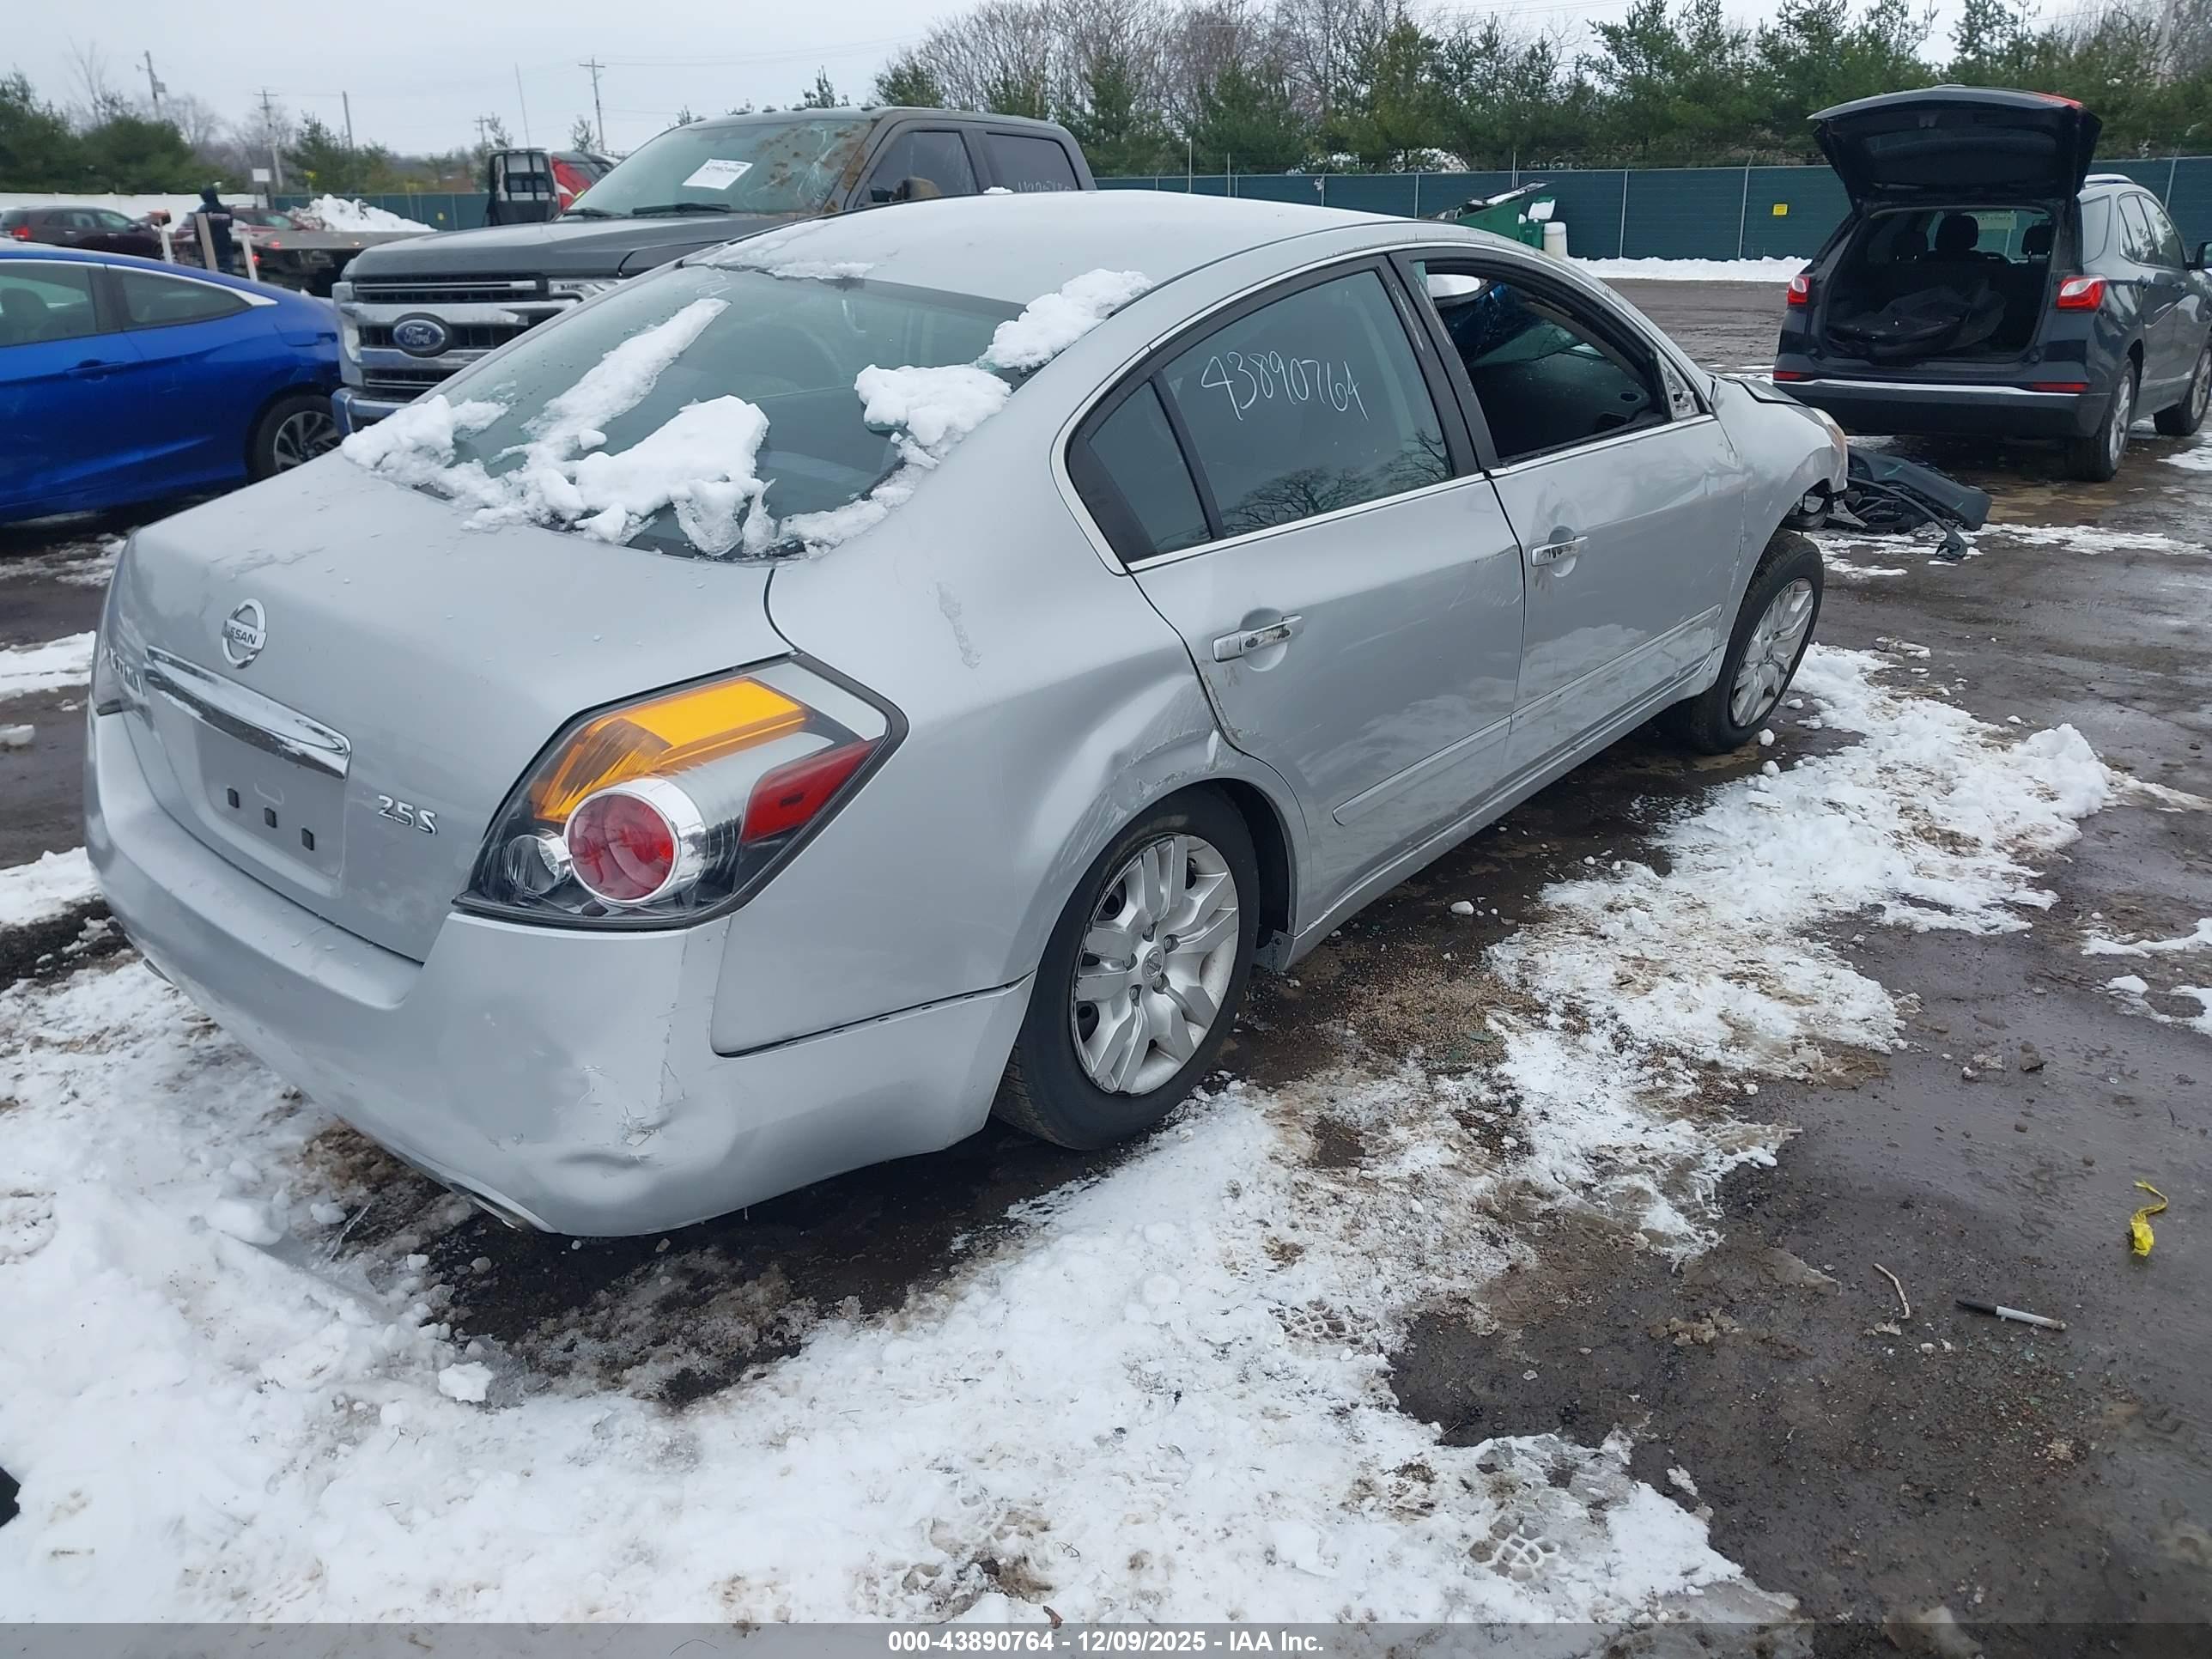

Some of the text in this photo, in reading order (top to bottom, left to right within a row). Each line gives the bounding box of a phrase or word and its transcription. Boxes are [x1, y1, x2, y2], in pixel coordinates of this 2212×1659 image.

[404, 326, 430, 344] Ford
[1201, 350, 1369, 420] 43890764
[225, 623, 257, 645] SSAN
